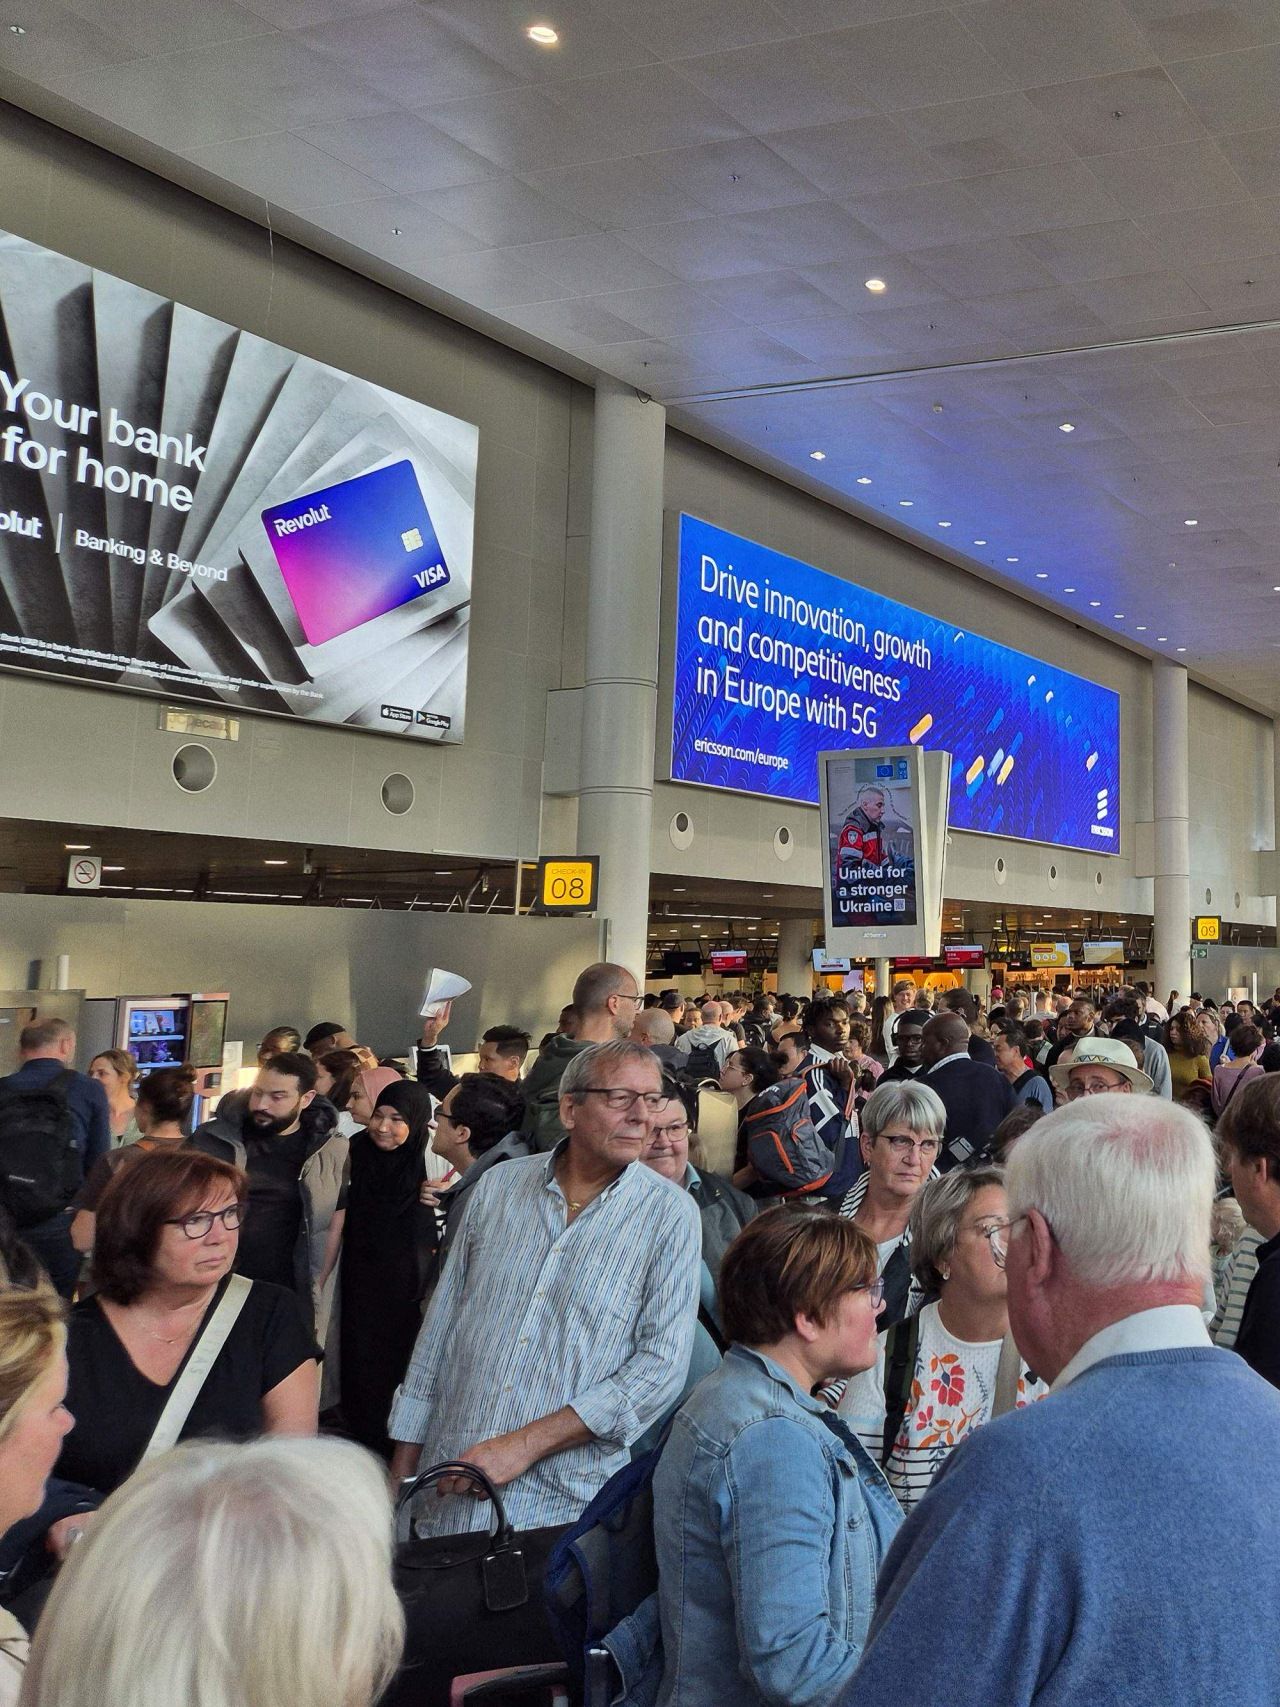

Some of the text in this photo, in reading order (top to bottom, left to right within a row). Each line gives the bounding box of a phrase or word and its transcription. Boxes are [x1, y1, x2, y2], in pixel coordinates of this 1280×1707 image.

[0, 370, 207, 473] Your bank
[1, 425, 194, 512] for home
[273, 503, 332, 538] Revolut
[75, 529, 228, 582] Banking & Beyond
[412, 563, 447, 589] VISA
[701, 554, 931, 671] Drive innovation, growth
[698, 615, 901, 702] and competitiveness
[696, 656, 878, 739] in Europe with 5G
[694, 737, 789, 771] ericsson.com/europe
[552, 878, 584, 899] 08
[839, 865, 906, 880] United for
[839, 884, 908, 898] a stronger
[839, 899, 893, 913] Ukraine
[1200, 925, 1216, 937] 09
